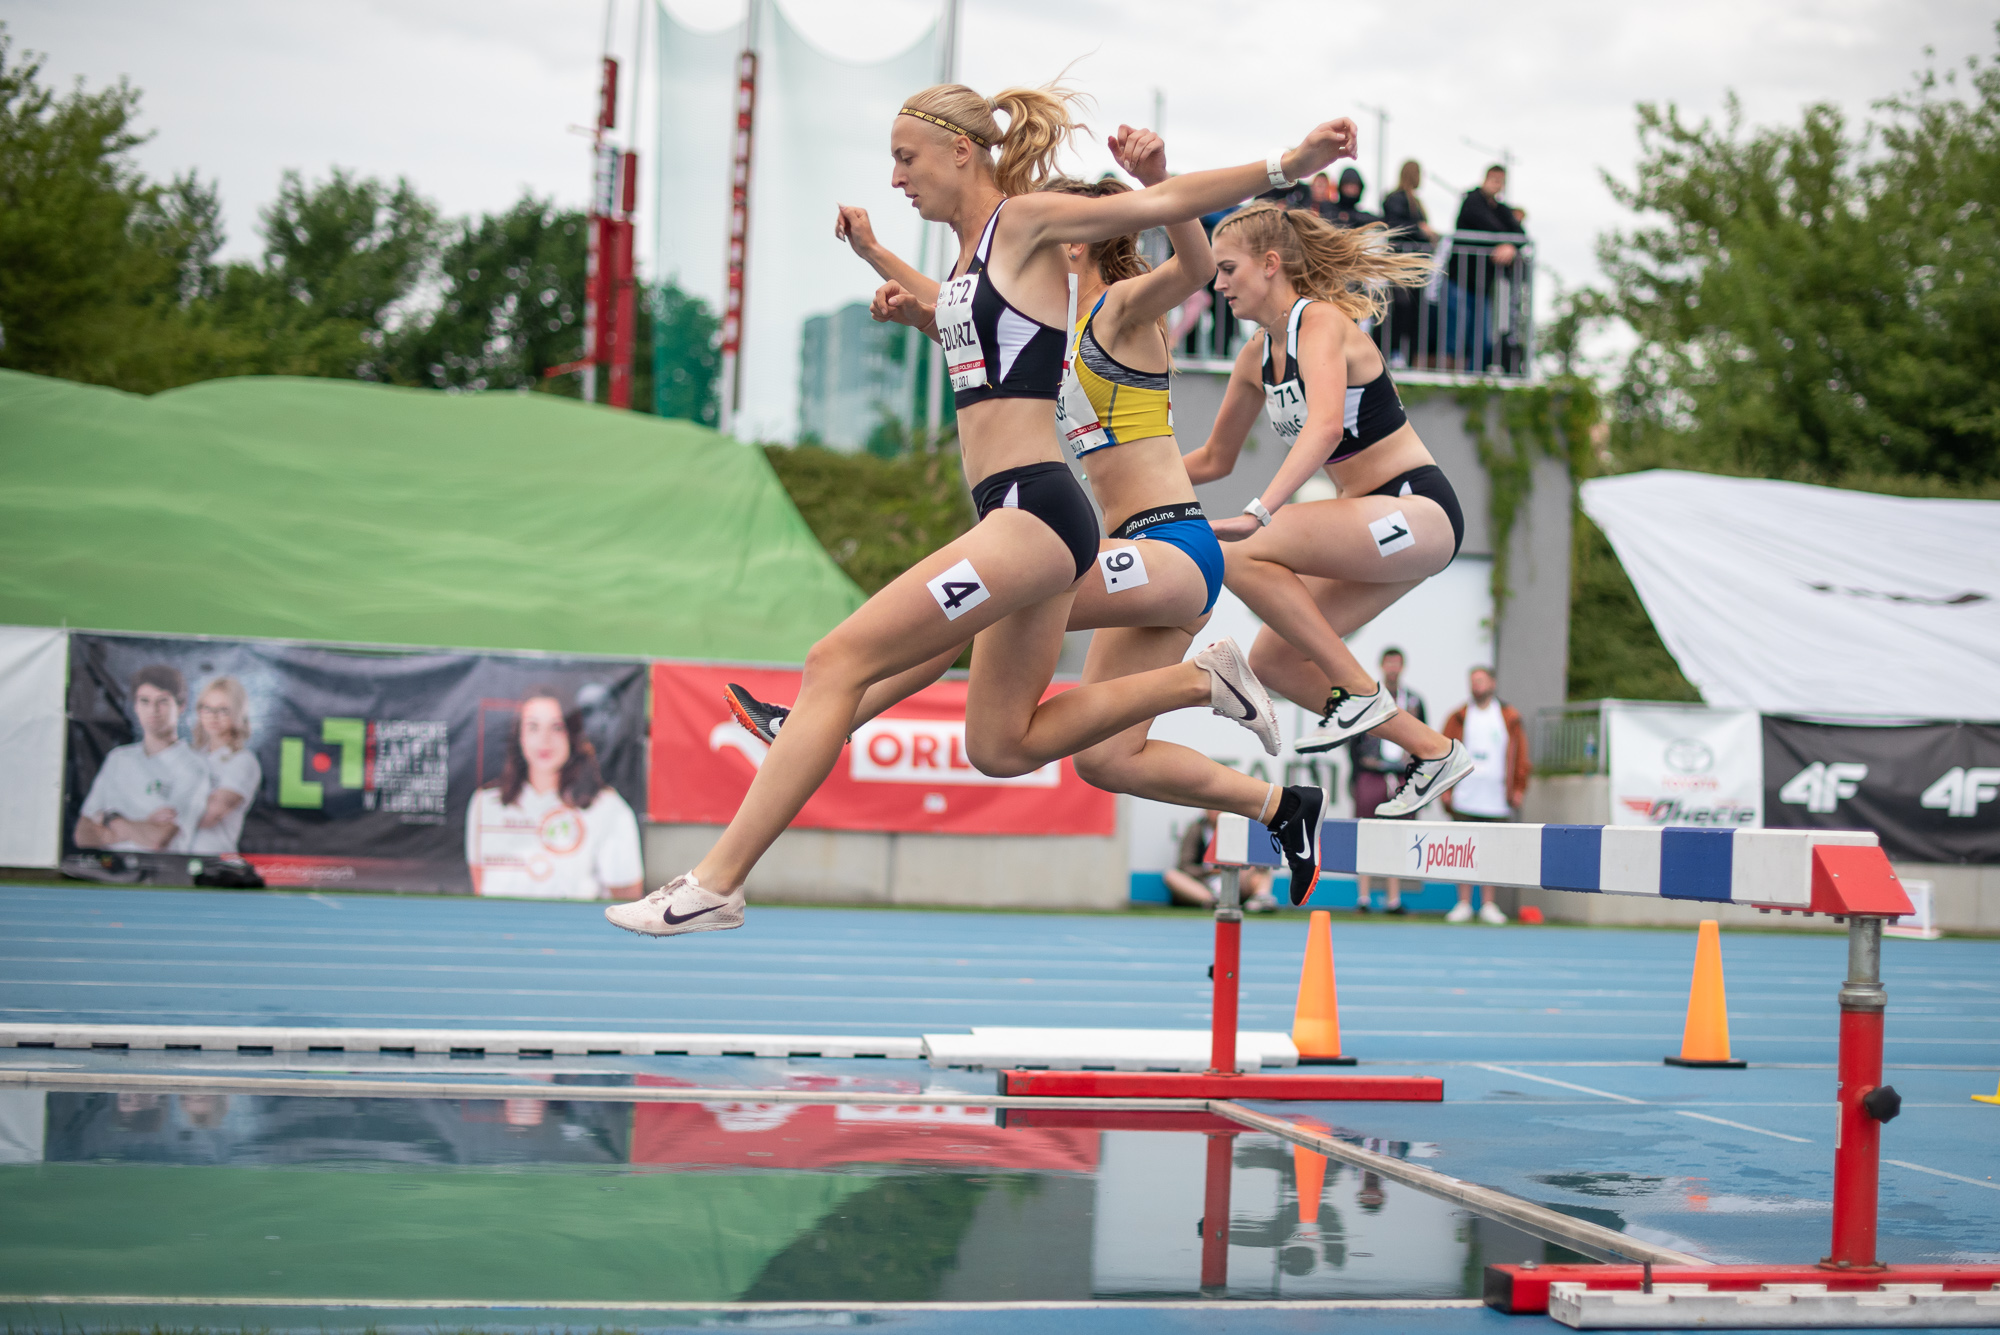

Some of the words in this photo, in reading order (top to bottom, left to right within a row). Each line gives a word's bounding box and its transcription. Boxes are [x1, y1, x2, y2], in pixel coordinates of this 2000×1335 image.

[1378, 525, 1408, 546] 1
[941, 581, 981, 610] 4
[868, 733, 972, 770] ORL
[1779, 761, 1869, 813] 4F
[1920, 766, 2000, 817] 4F
[1426, 835, 1476, 873] polanik
